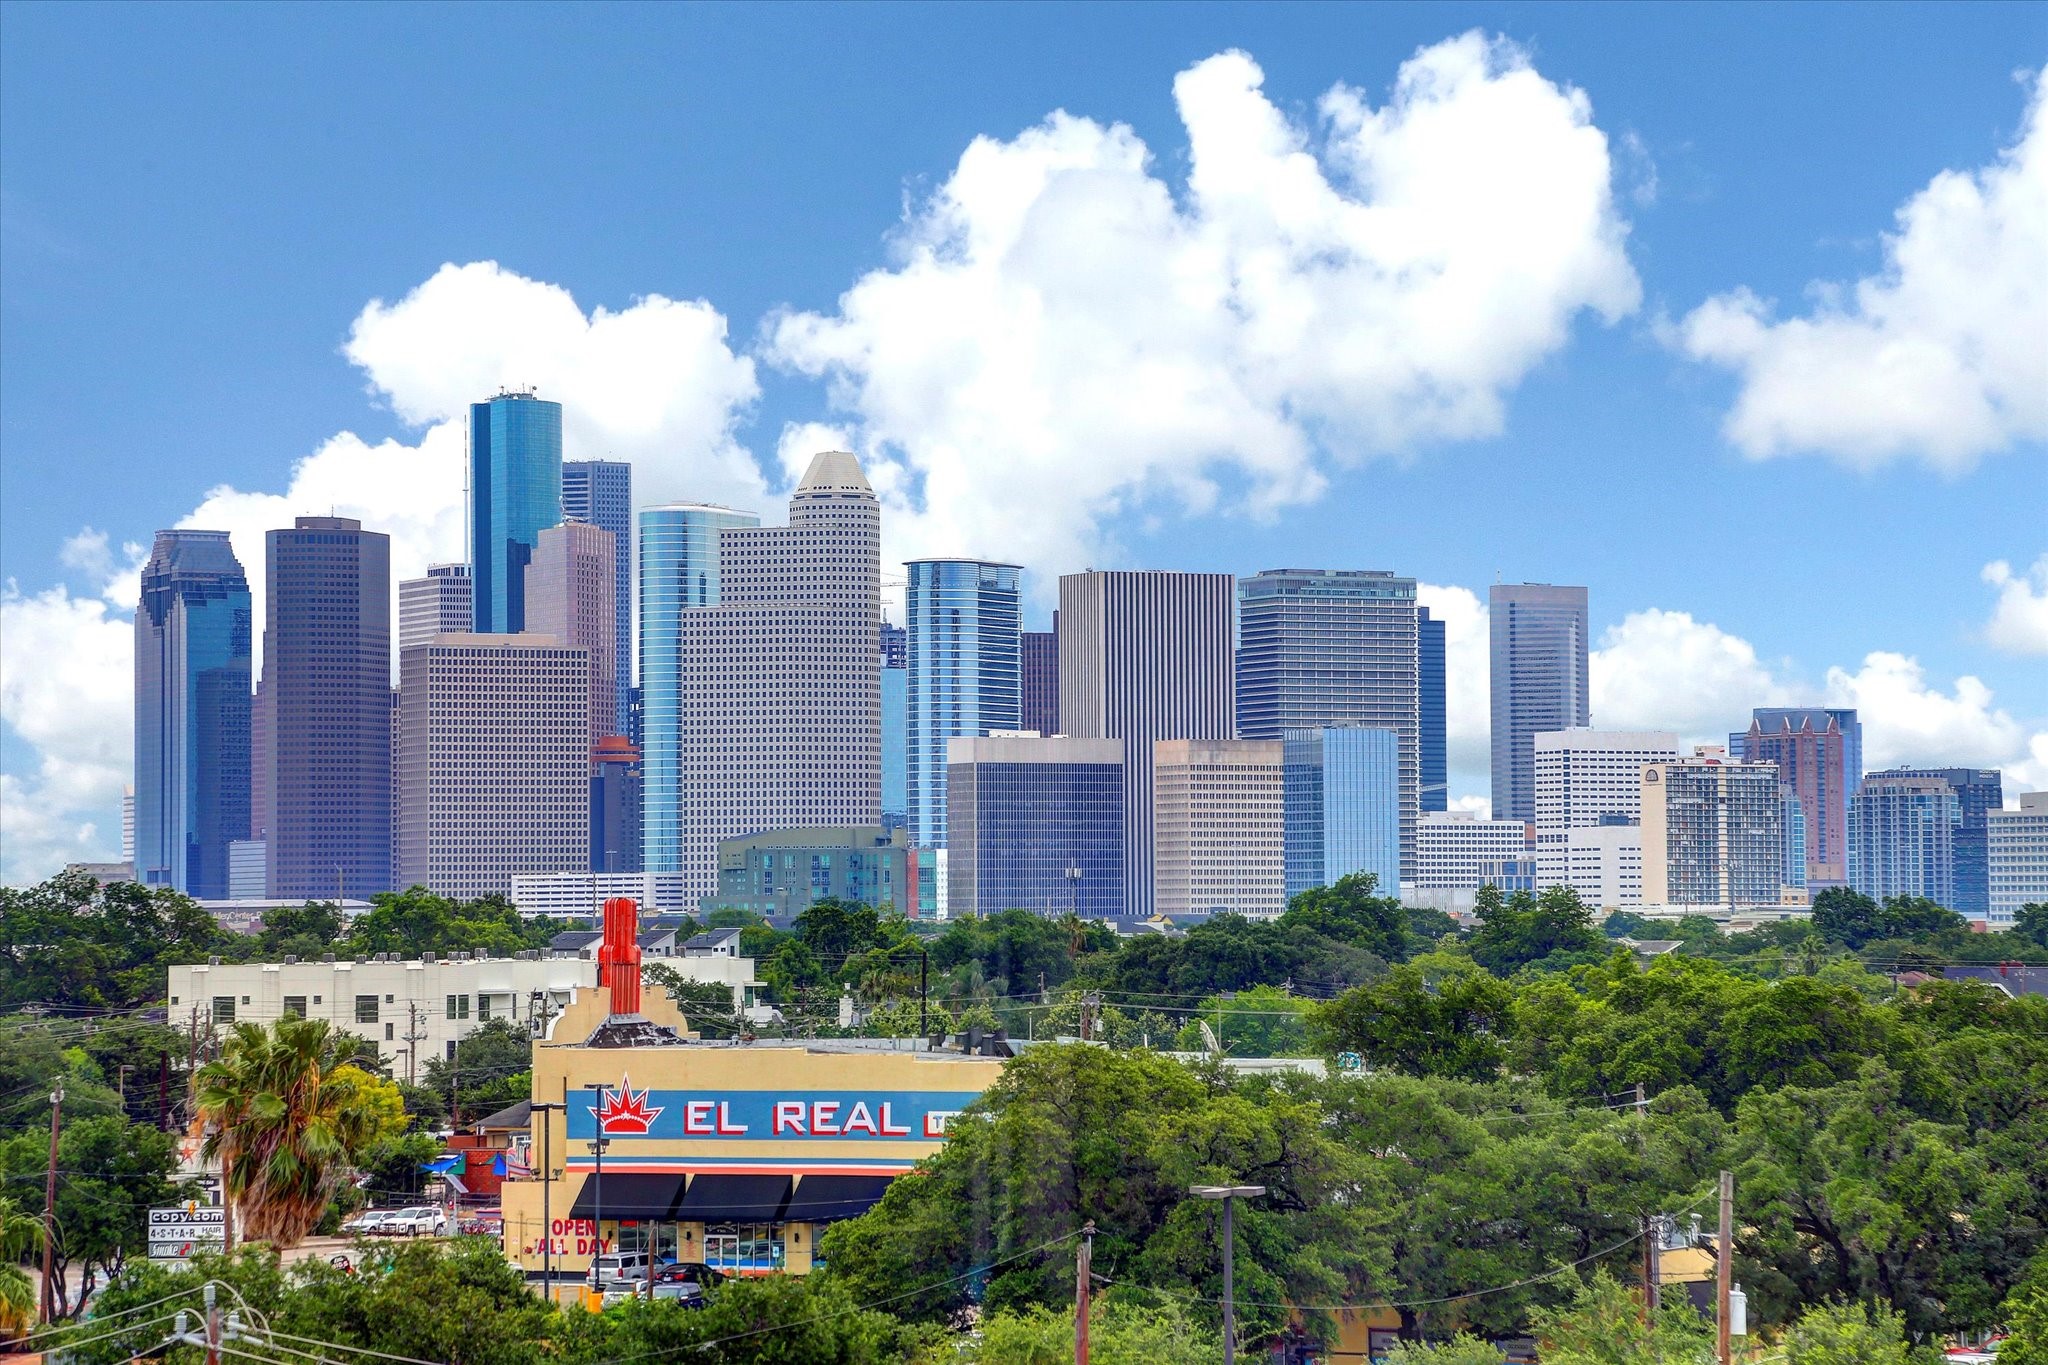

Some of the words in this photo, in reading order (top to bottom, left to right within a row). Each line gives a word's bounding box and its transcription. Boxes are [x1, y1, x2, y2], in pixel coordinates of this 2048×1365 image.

[684, 1101, 748, 1135] EL
[772, 1101, 911, 1135] REAL
[152, 1212, 224, 1223] copy.com
[201, 1226, 221, 1235] HAIR
[551, 1218, 596, 1237] OPEN
[151, 1243, 178, 1257] Smoke
[537, 1238, 569, 1255] ALL
[576, 1238, 610, 1255] DAY
